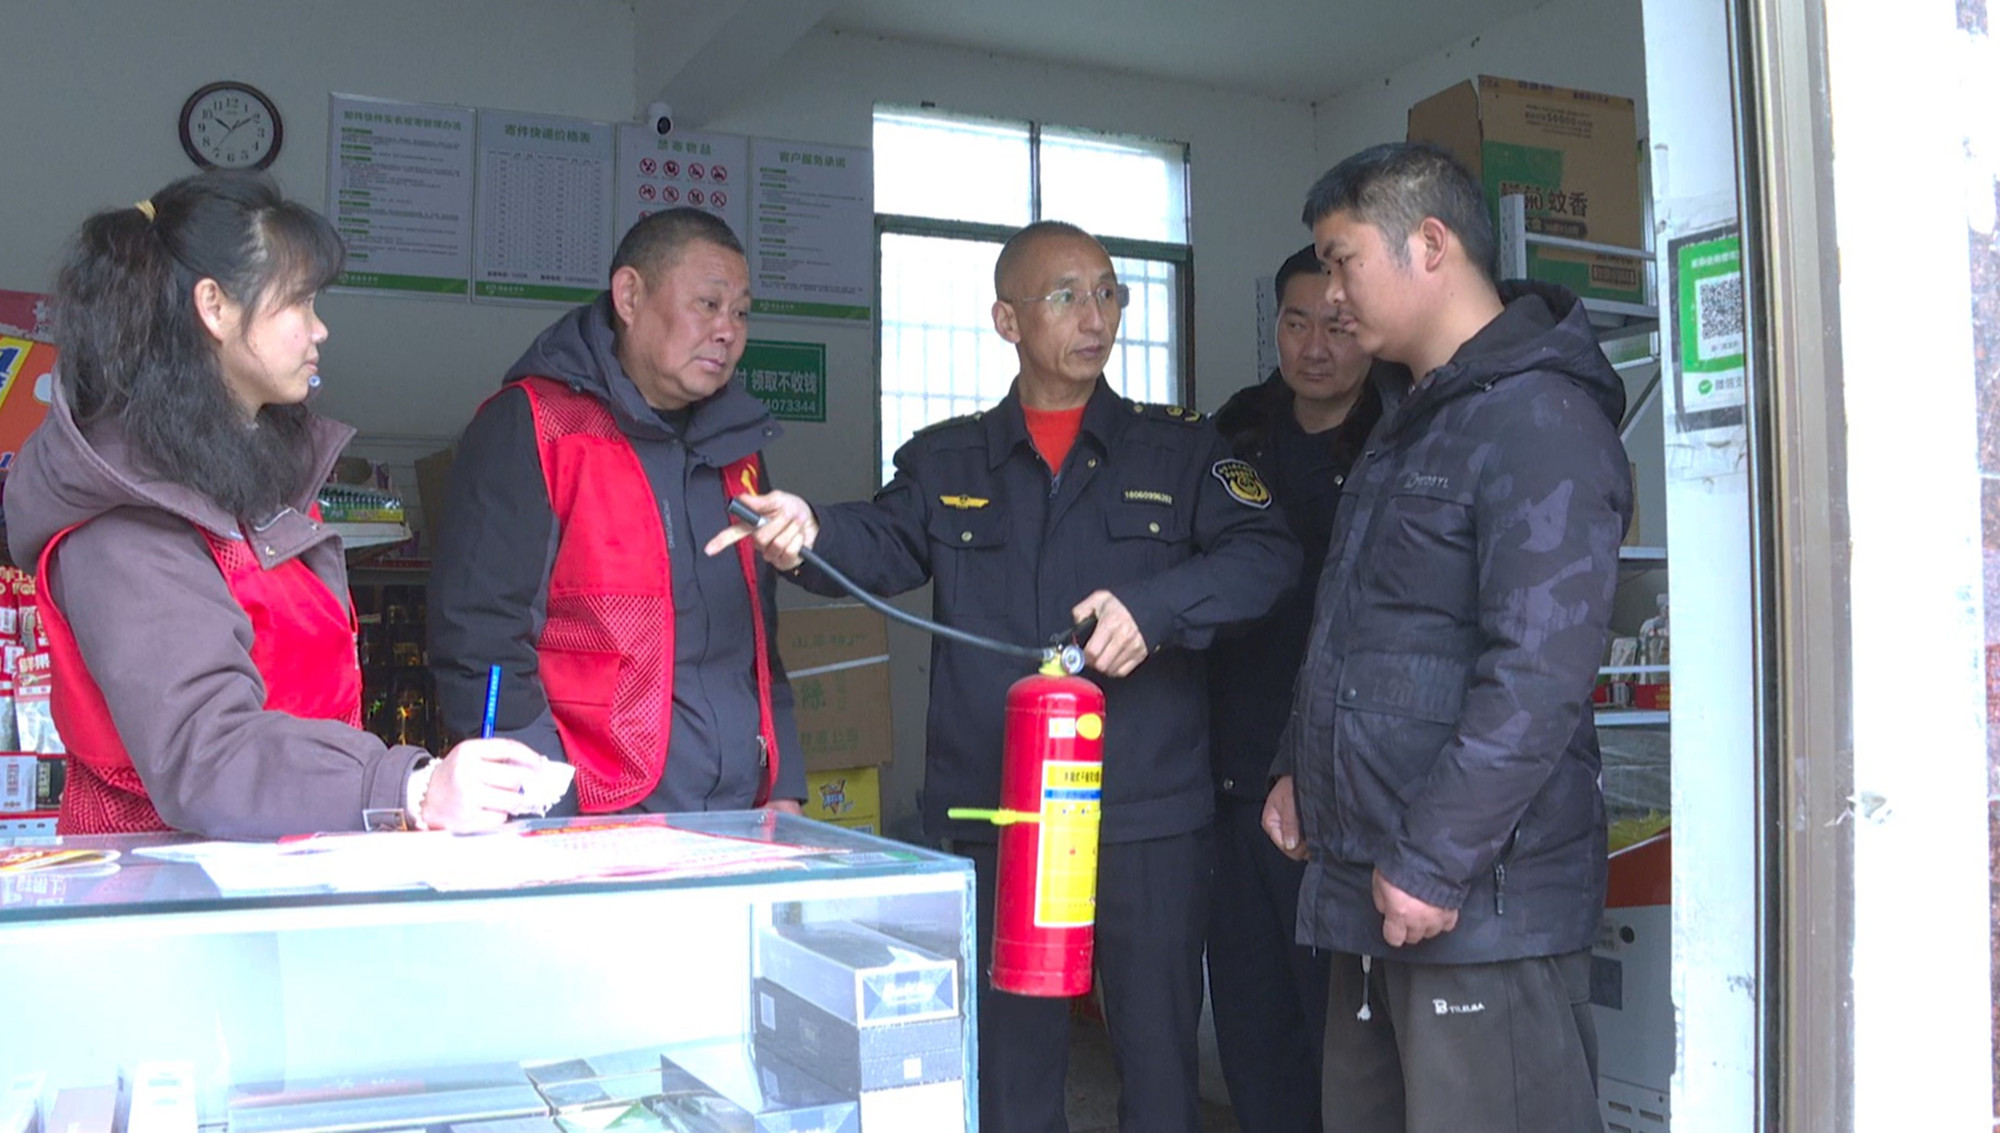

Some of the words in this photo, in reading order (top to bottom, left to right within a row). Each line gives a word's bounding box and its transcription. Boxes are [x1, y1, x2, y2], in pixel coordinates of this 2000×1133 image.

[213, 100, 223, 111] 11
[226, 97, 239, 109] 12
[243, 103, 248, 113] 1
[202, 109, 213, 120] 10
[253, 113, 261, 124] 2
[197, 123, 206, 133] 9
[257, 128, 265, 138] 3
[505, 123, 591, 143] 寄件快递价格表
[202, 136, 210, 147] 8
[252, 141, 259, 151] 4
[212, 147, 220, 158] 7
[227, 152, 235, 163] 6
[241, 150, 249, 160] 5
[779, 150, 847, 168] 客户服务承诺
[751, 369, 817, 394] 领取不收钱
